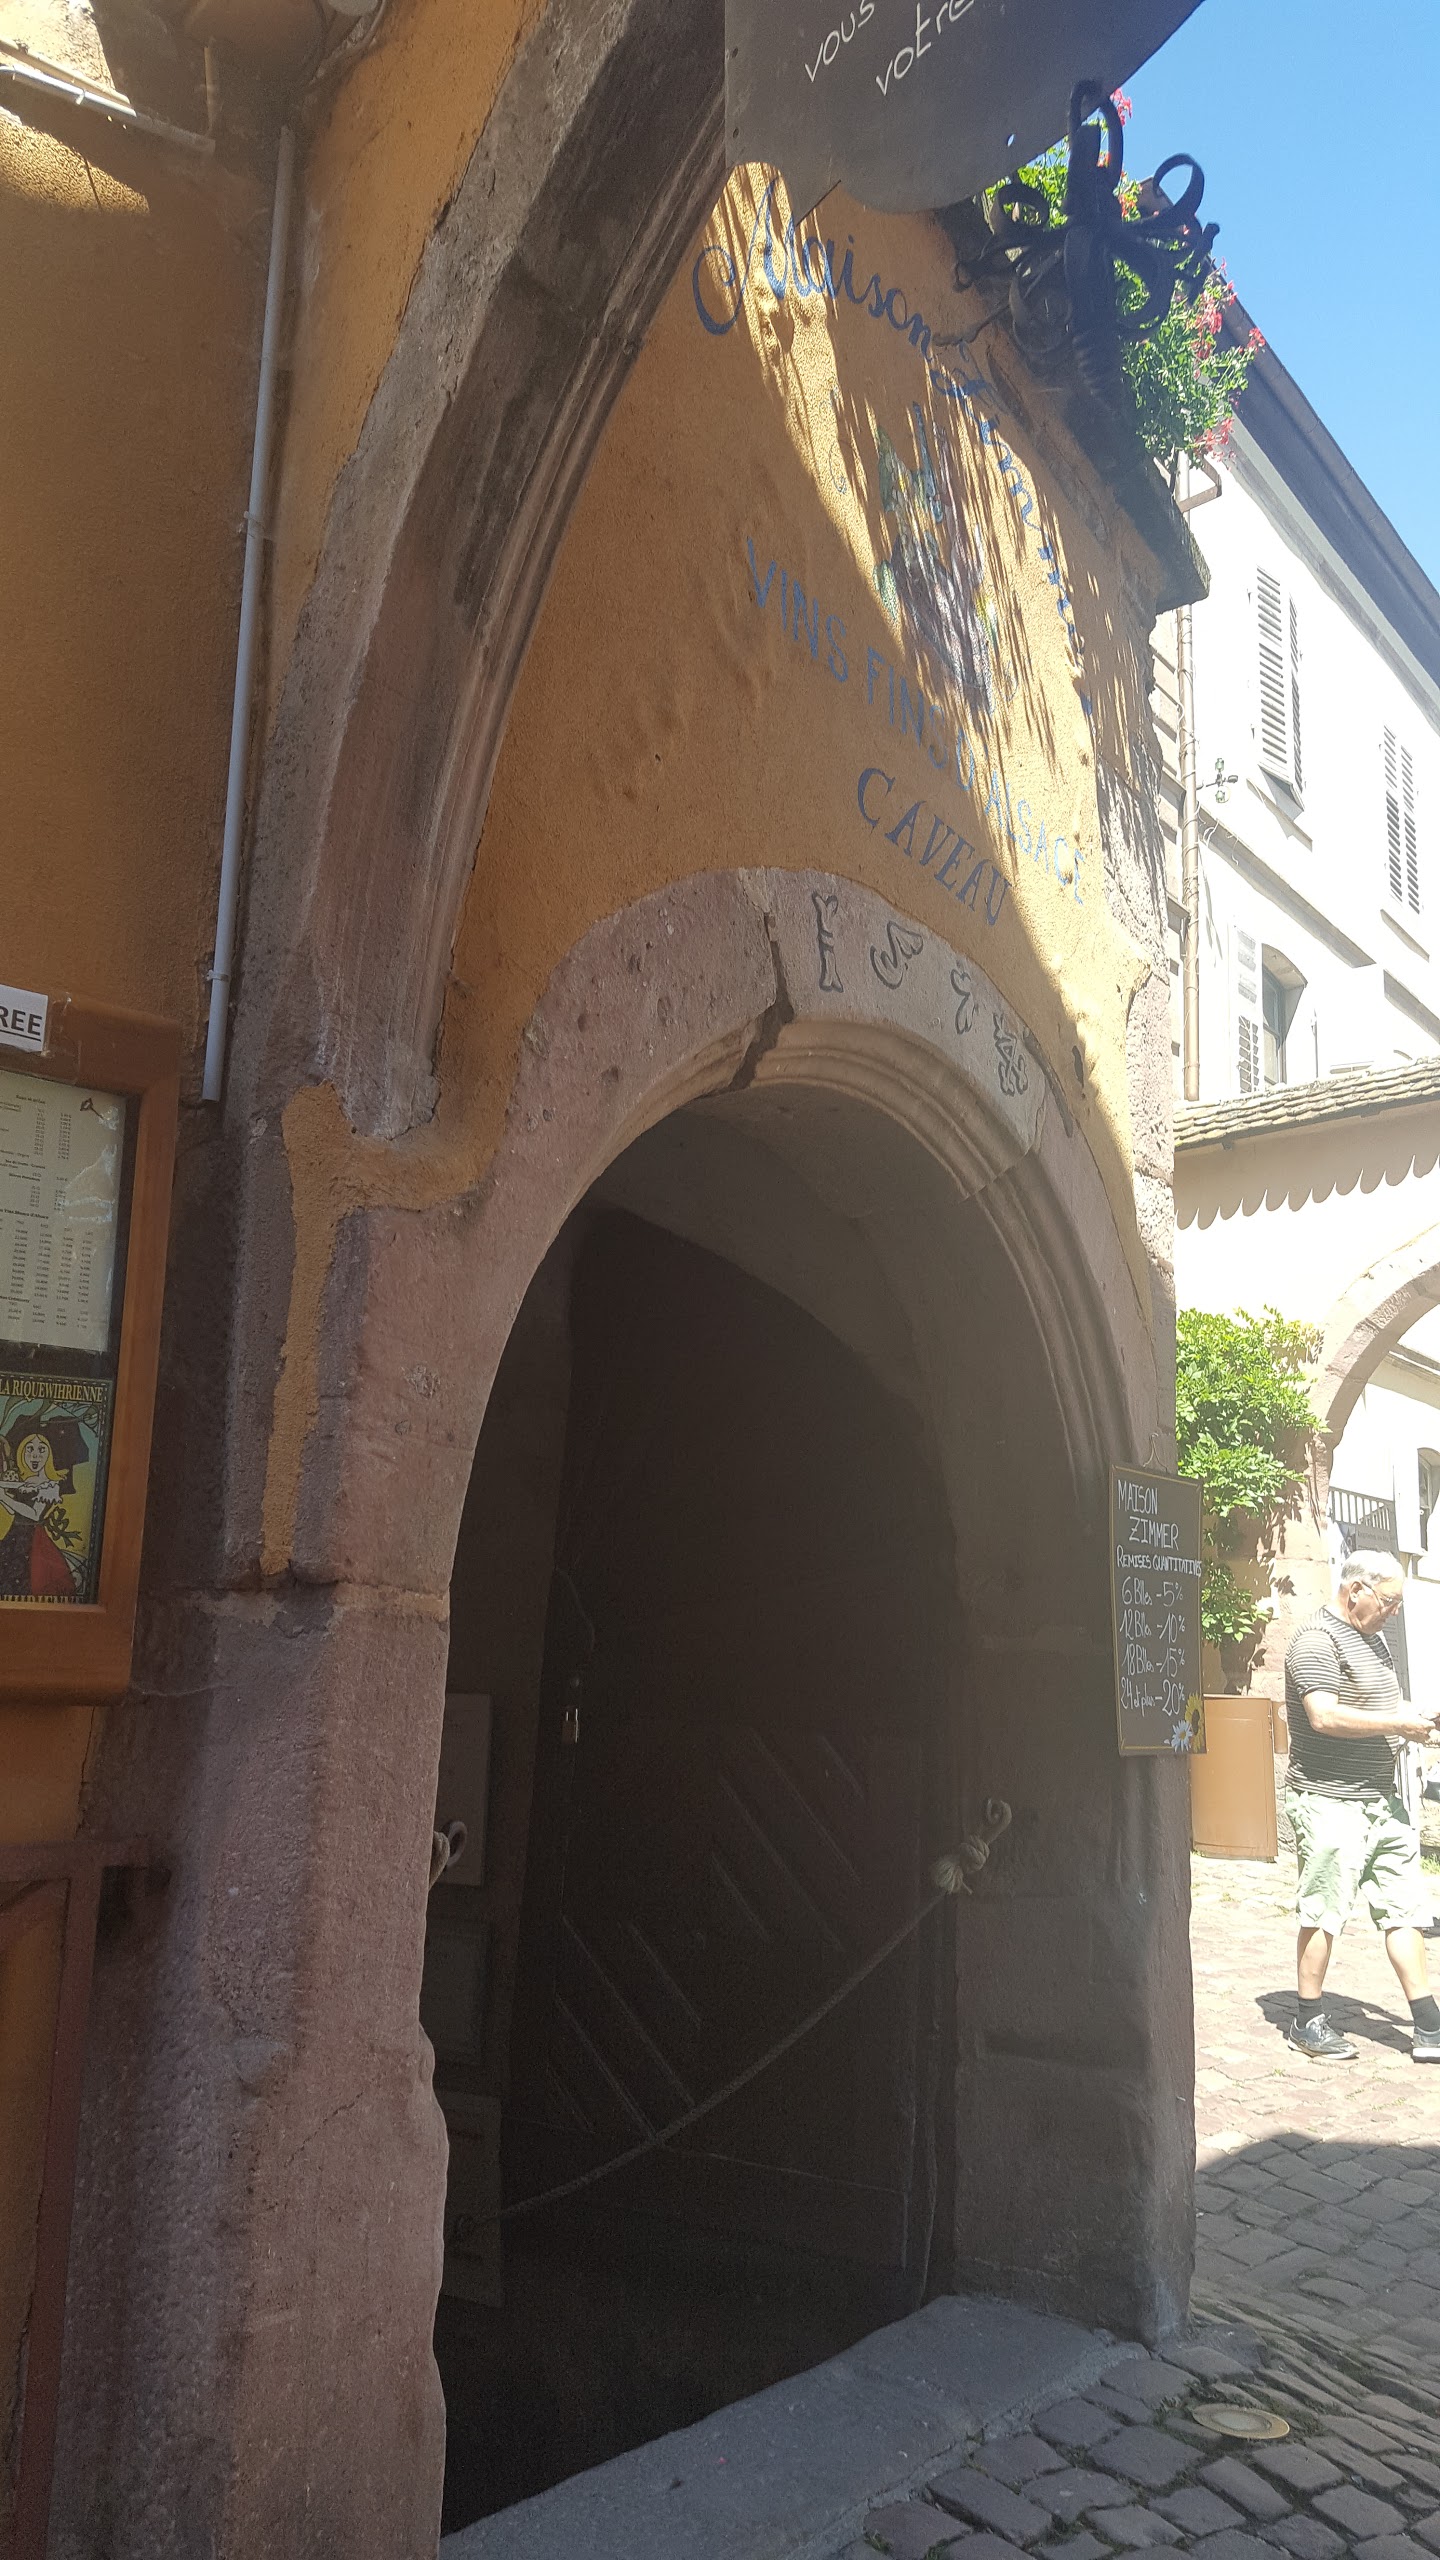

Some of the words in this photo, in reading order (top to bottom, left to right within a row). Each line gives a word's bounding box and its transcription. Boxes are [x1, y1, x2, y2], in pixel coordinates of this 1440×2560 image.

[805, 0, 875, 82] vous
[875, 0, 975, 96] votre
[693, 176, 933, 362] Maison
[747, 535, 848, 683] VINS
[867, 645, 949, 770] FINS
[857, 767, 1013, 927] CAVEAU
[12, 1379, 103, 1402] RIQUEWIHRIENNE
[1117, 1479, 1158, 1515] MAISON
[1128, 1516, 1179, 1551] ZIMMER
[1120, 1676, 1134, 1710] 24
